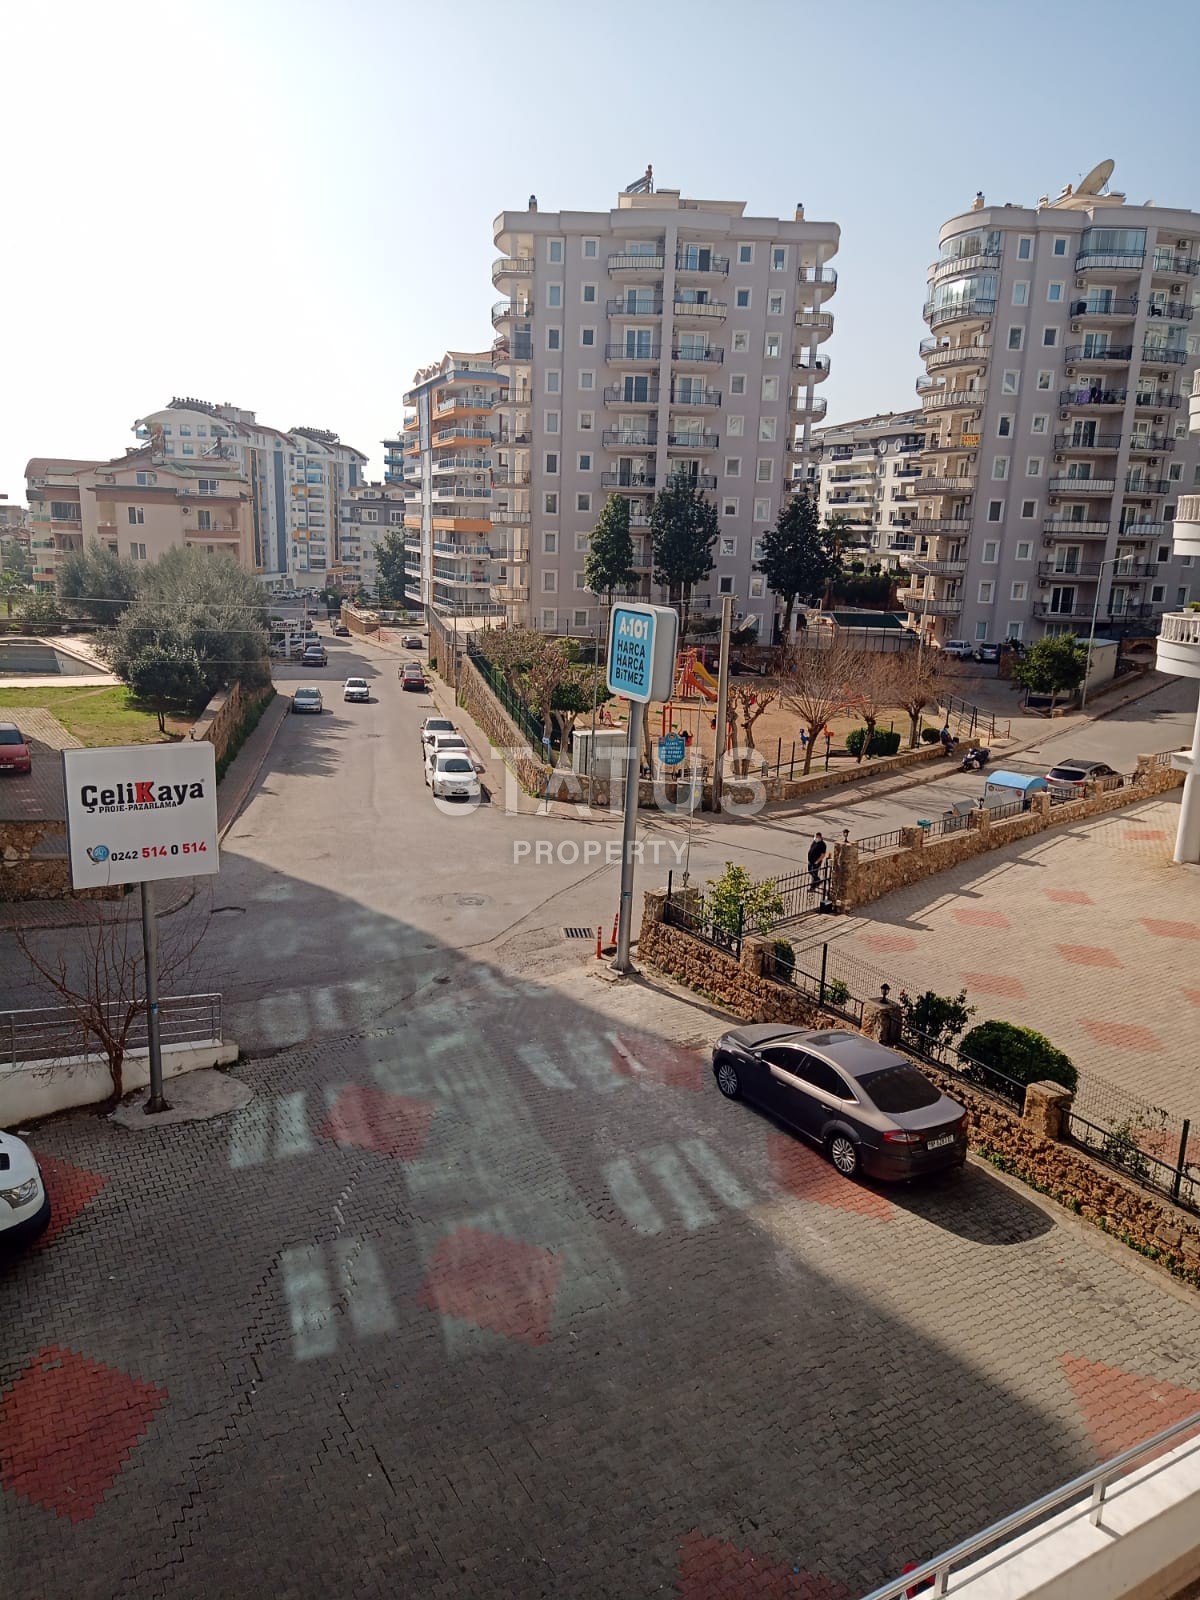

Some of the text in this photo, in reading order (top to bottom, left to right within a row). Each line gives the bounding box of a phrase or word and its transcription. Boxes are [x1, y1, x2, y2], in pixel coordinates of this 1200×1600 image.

[617, 640, 646, 659] HARCA
[616, 654, 644, 673] HARCA
[111, 850, 139, 862] 0242
[142, 845, 168, 858] 514
[182, 841, 207, 854] 514
